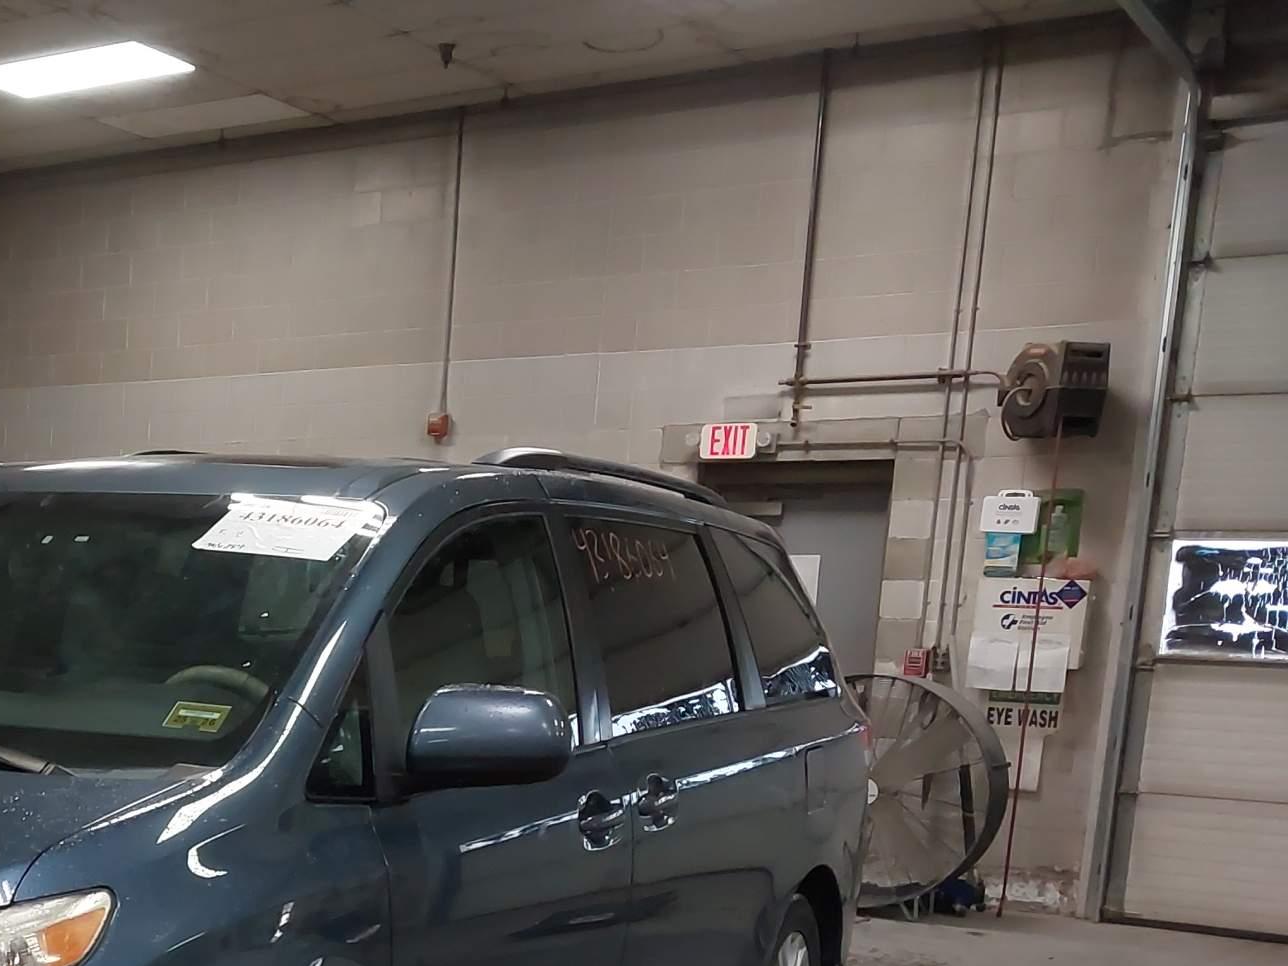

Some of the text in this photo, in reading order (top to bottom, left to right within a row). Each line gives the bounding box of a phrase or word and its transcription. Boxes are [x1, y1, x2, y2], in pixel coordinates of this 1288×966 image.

[710, 425, 750, 455] EXIT
[240, 511, 346, 529] 43186064
[987, 707, 1059, 728] EYE WASH
